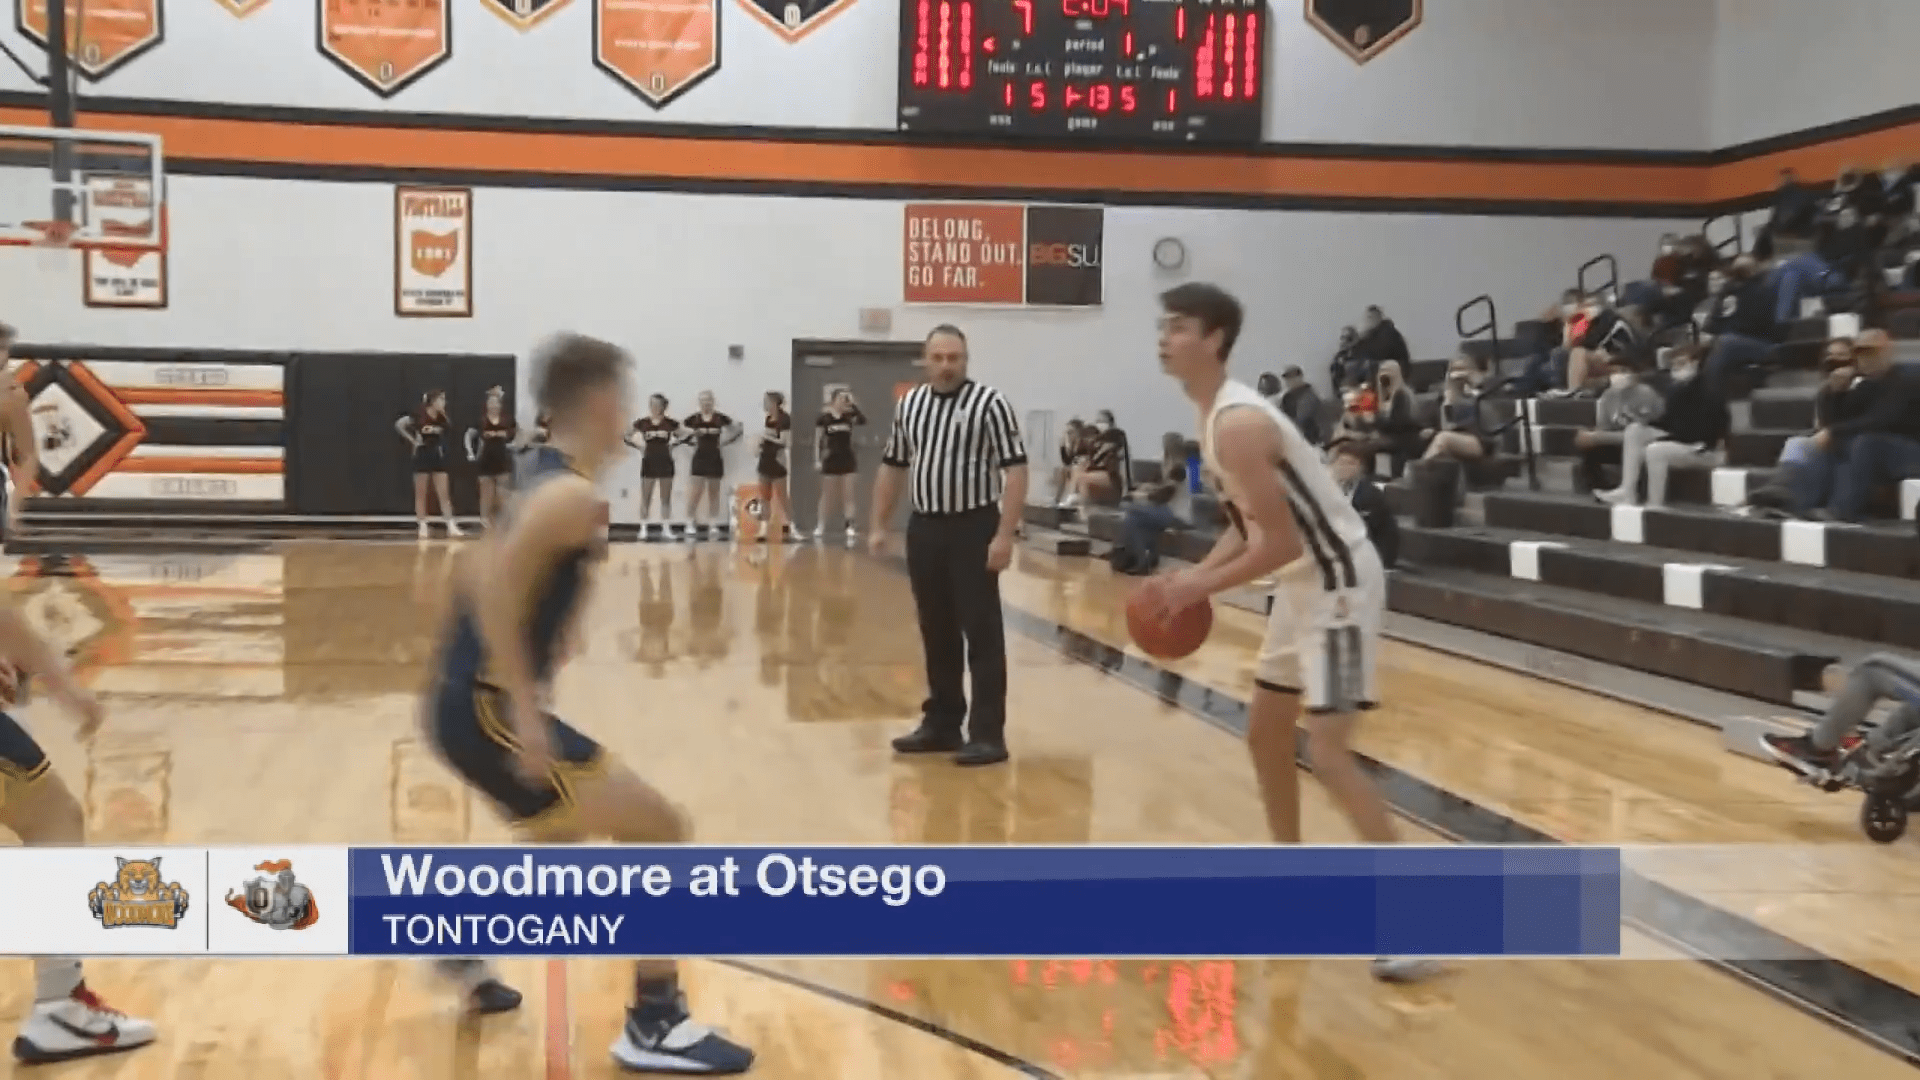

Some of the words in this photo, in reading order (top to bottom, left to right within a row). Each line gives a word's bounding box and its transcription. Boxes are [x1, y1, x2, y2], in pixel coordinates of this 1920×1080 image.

[1064, 38, 1105, 52] period
[1064, 62, 1104, 79] player
[1030, 82, 1045, 108] 5
[1120, 85, 1136, 111] 5
[908, 217, 990, 241] BELONG,
[908, 241, 972, 265] STAND
[980, 243, 1023, 266] OUT.
[908, 265, 934, 287] GO
[943, 266, 985, 288] FAR.
